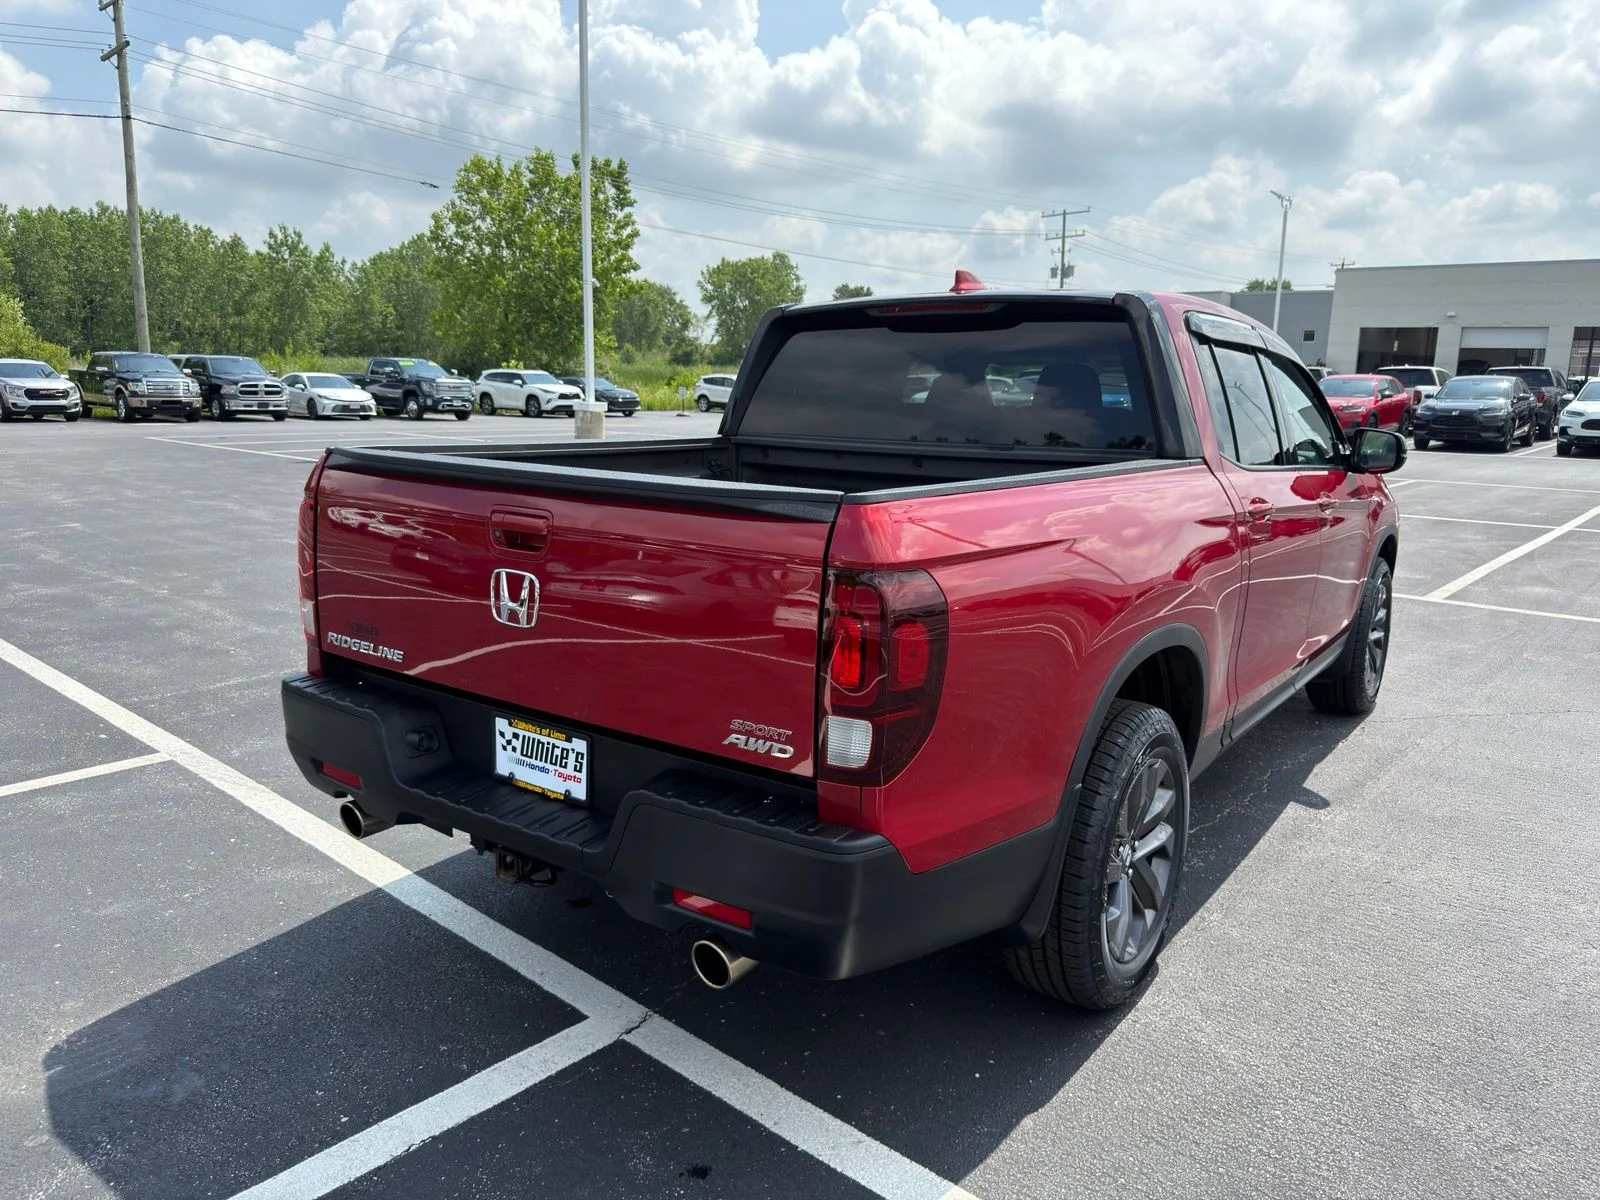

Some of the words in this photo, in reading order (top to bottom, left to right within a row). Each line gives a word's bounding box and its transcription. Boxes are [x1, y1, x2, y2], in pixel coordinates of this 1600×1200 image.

[327, 631, 405, 663] RIDGELINE
[517, 719, 541, 734] White's
[541, 728, 549, 736] of
[550, 729, 566, 740] Lima
[729, 719, 793, 741] SPORT
[520, 734, 585, 773] White's
[722, 733, 795, 758] AWD
[525, 760, 550, 774] Honda
[553, 769, 582, 784] Toyota
